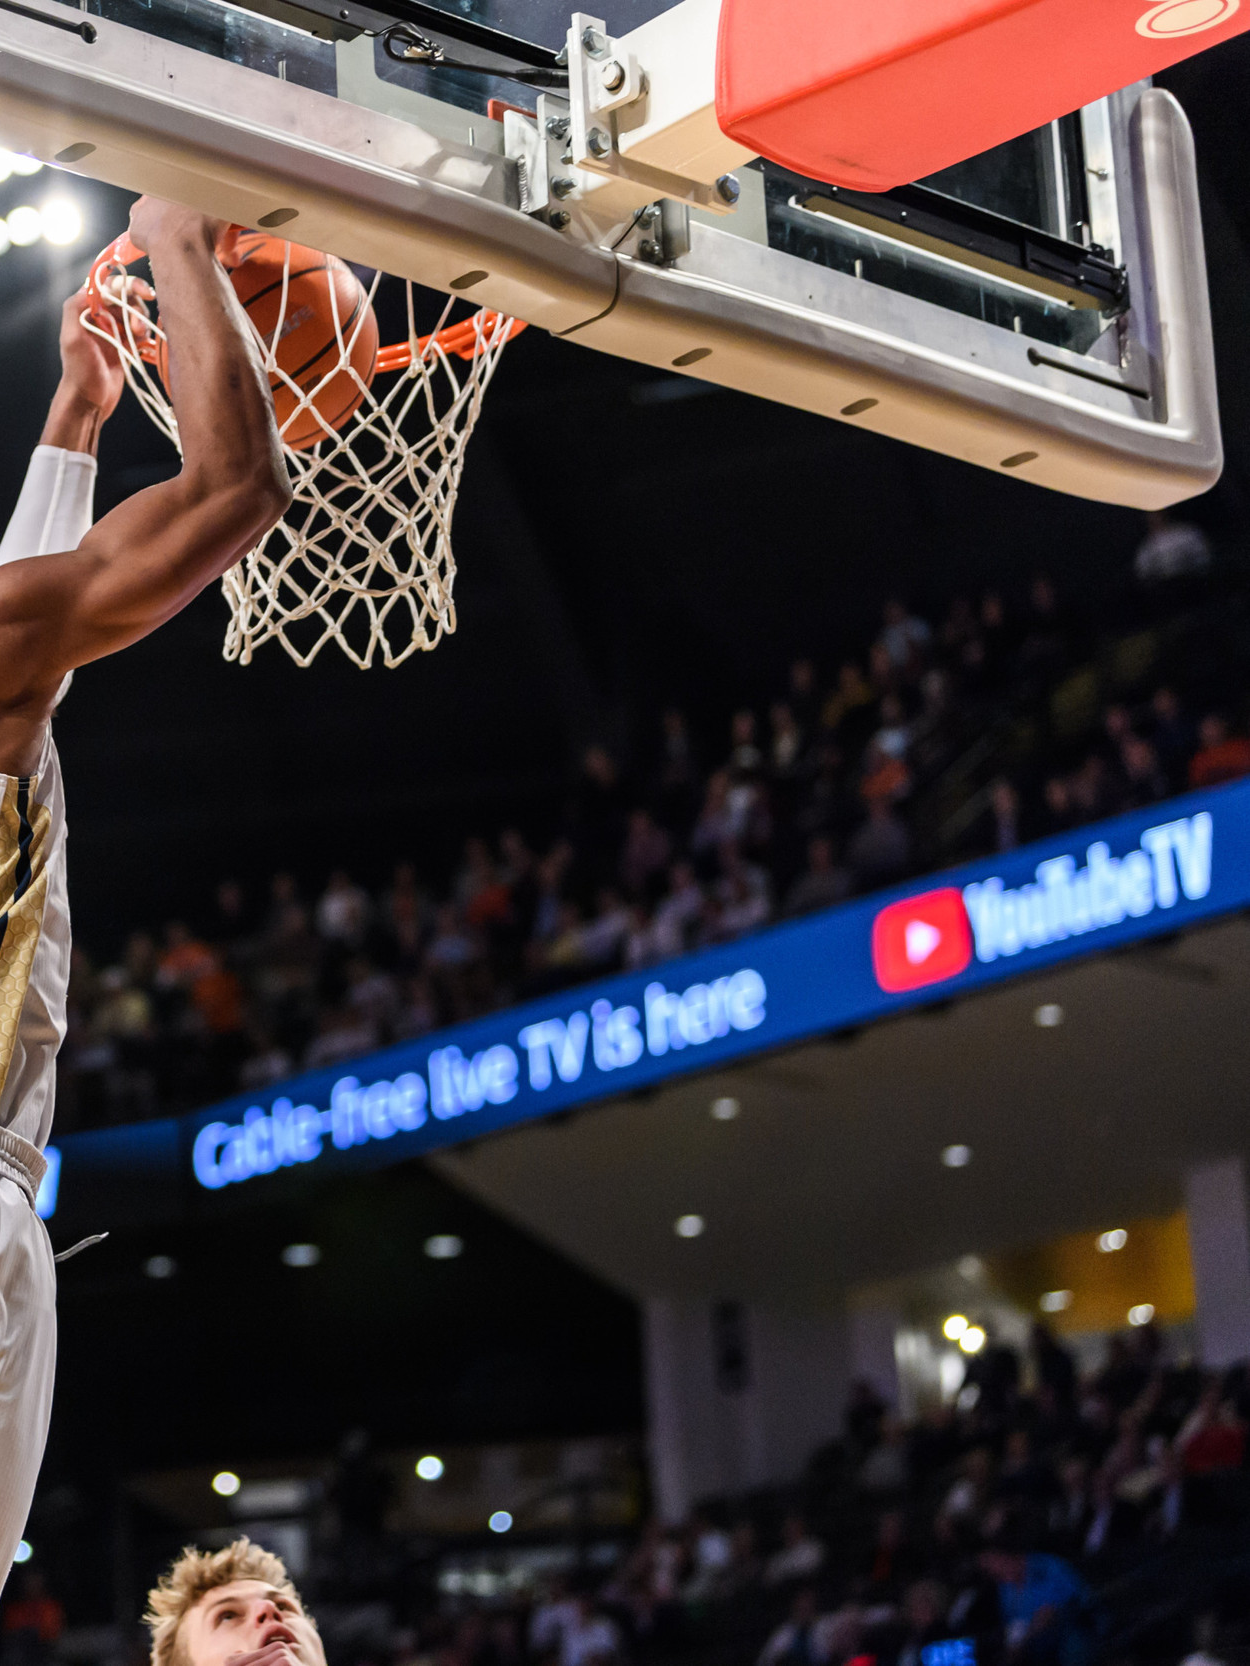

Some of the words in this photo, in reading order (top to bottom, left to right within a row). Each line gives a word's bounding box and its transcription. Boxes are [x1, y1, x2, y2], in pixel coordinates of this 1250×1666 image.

[193, 1076, 428, 1189] Cable-free
[428, 1045, 519, 1120] live
[519, 1011, 590, 1091] TV
[592, 999, 645, 1072] is
[645, 968, 767, 1057] here
